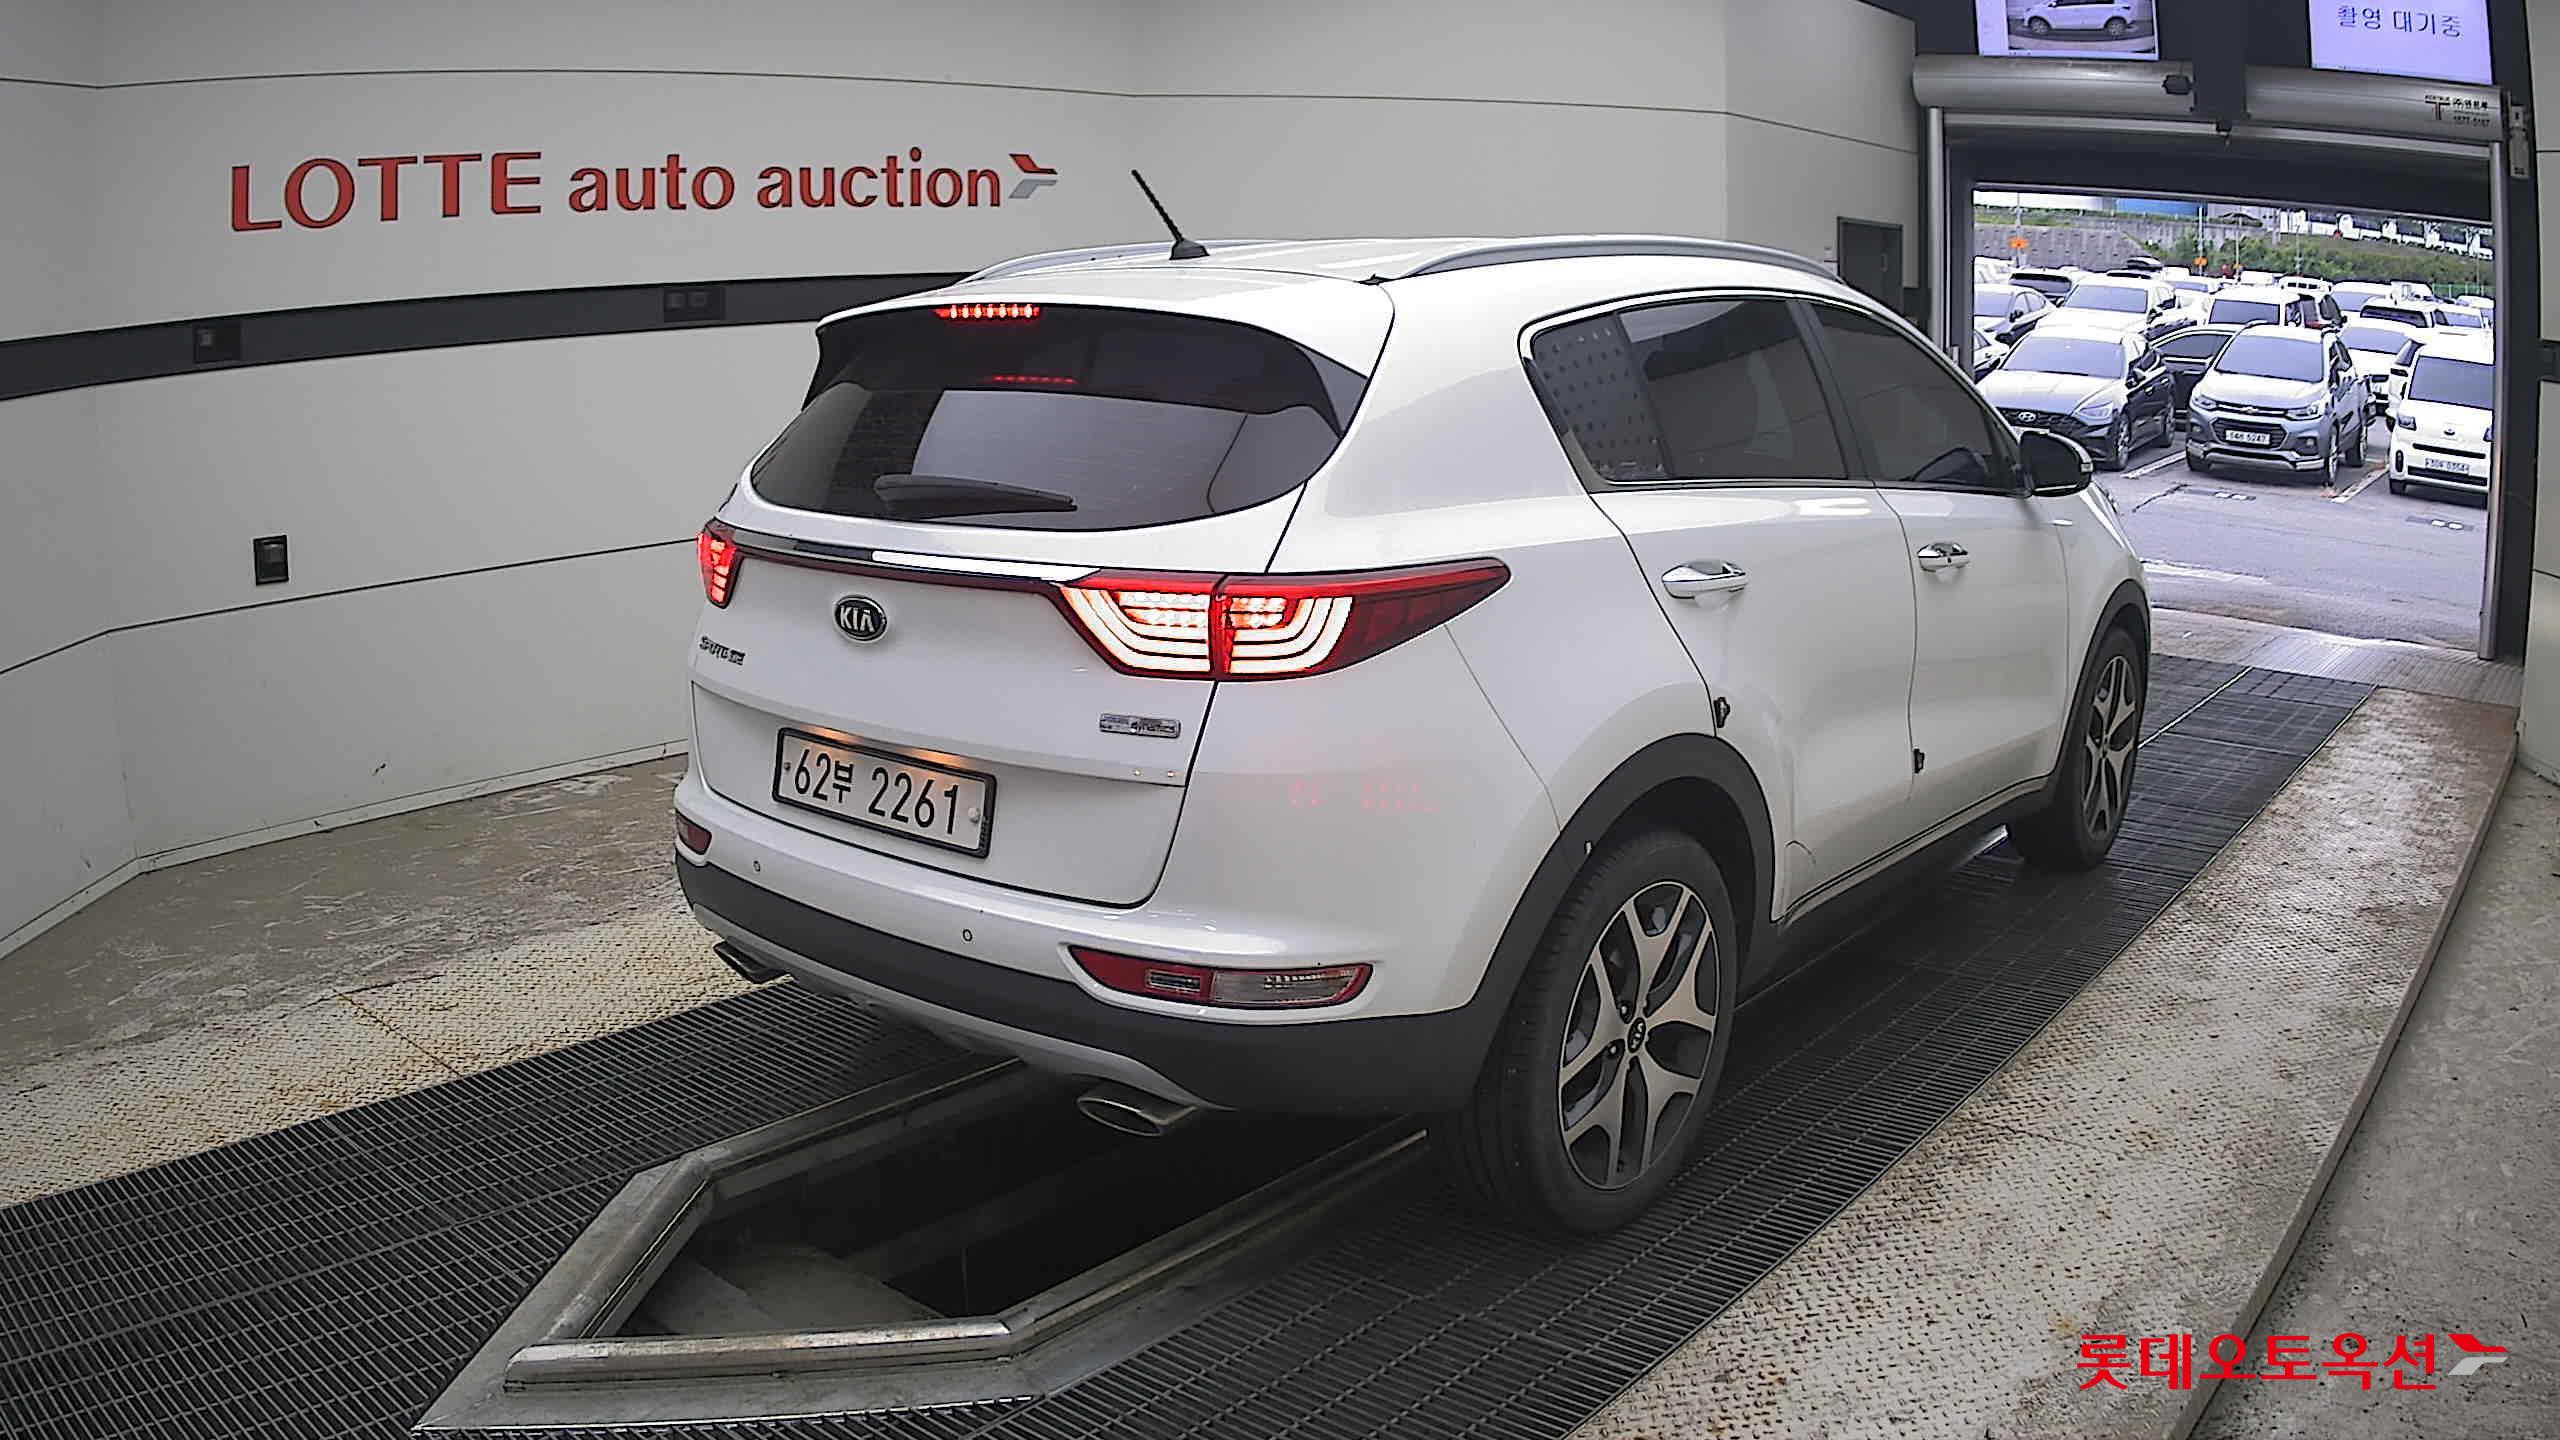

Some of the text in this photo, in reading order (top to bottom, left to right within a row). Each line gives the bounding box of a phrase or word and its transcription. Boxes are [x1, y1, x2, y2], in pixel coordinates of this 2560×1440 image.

[2337, 5, 2461, 38] 촬영 대기중
[231, 147, 1002, 232] LOTTE auto auction
[840, 606, 876, 633] KIA
[794, 749, 855, 804] 62부
[868, 766, 959, 835] 2261
